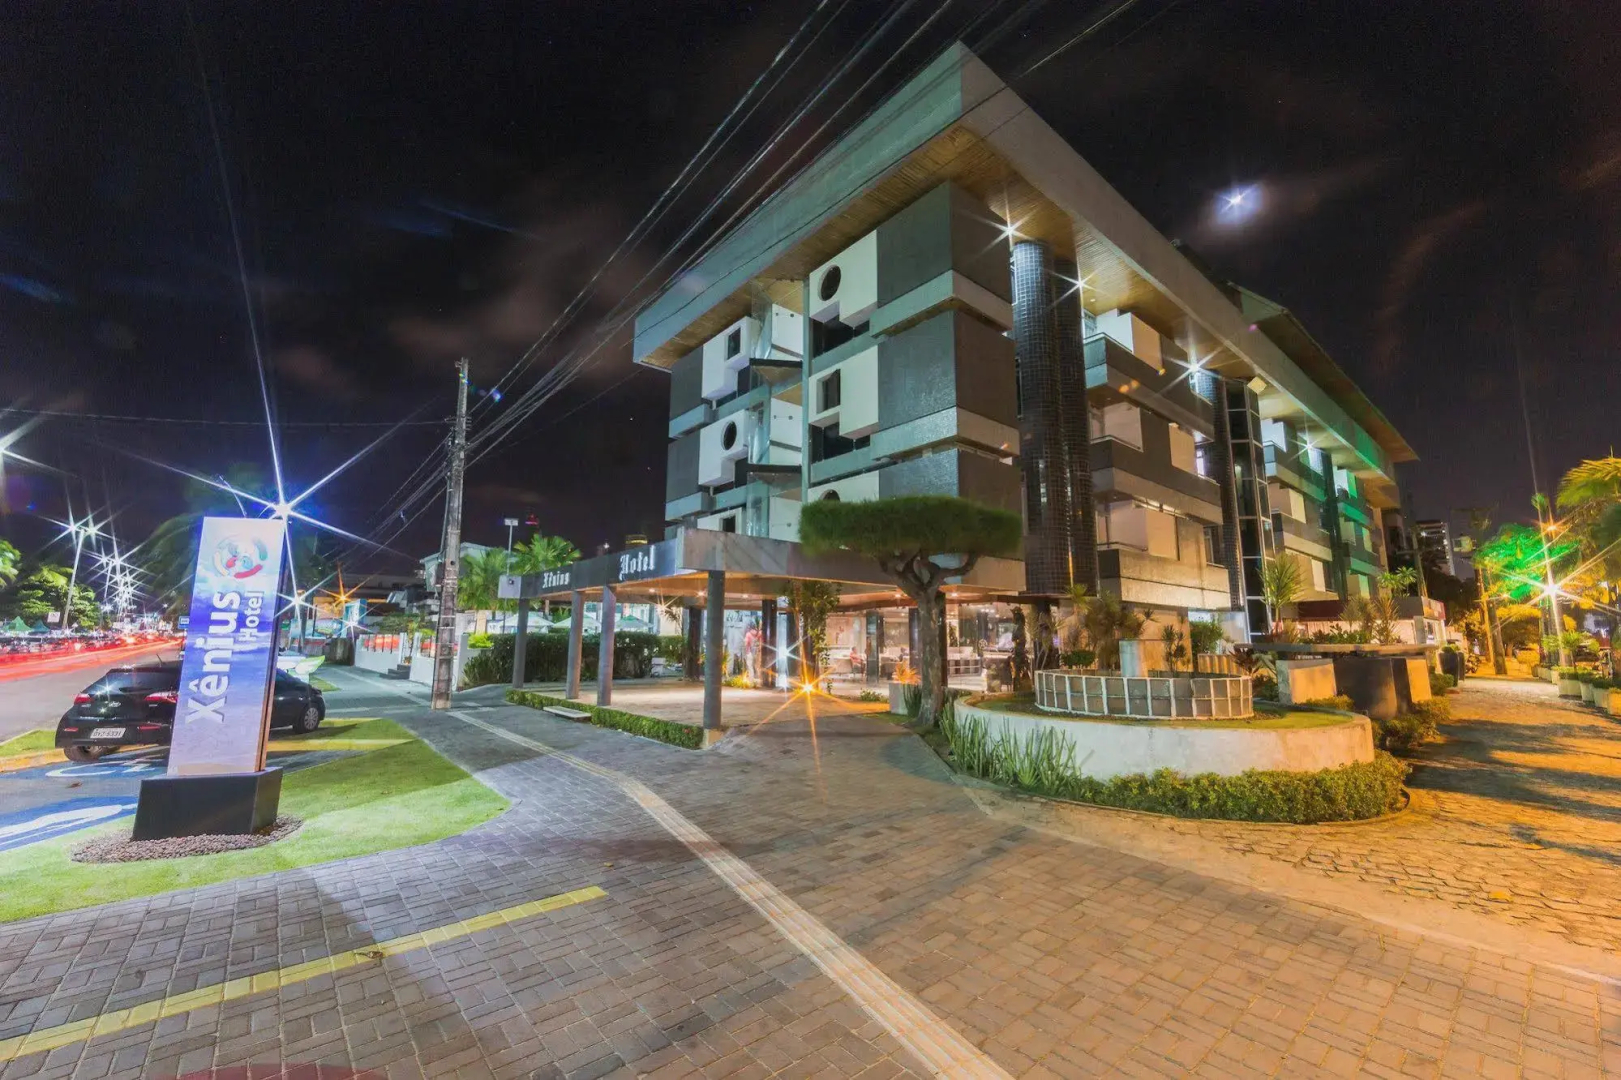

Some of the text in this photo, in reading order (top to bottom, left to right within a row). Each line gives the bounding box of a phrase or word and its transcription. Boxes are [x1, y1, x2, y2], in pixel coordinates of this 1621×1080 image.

[619, 545, 655, 580] Hotel
[238, 590, 264, 642] Hotel
[185, 591, 241, 724] Xênius
